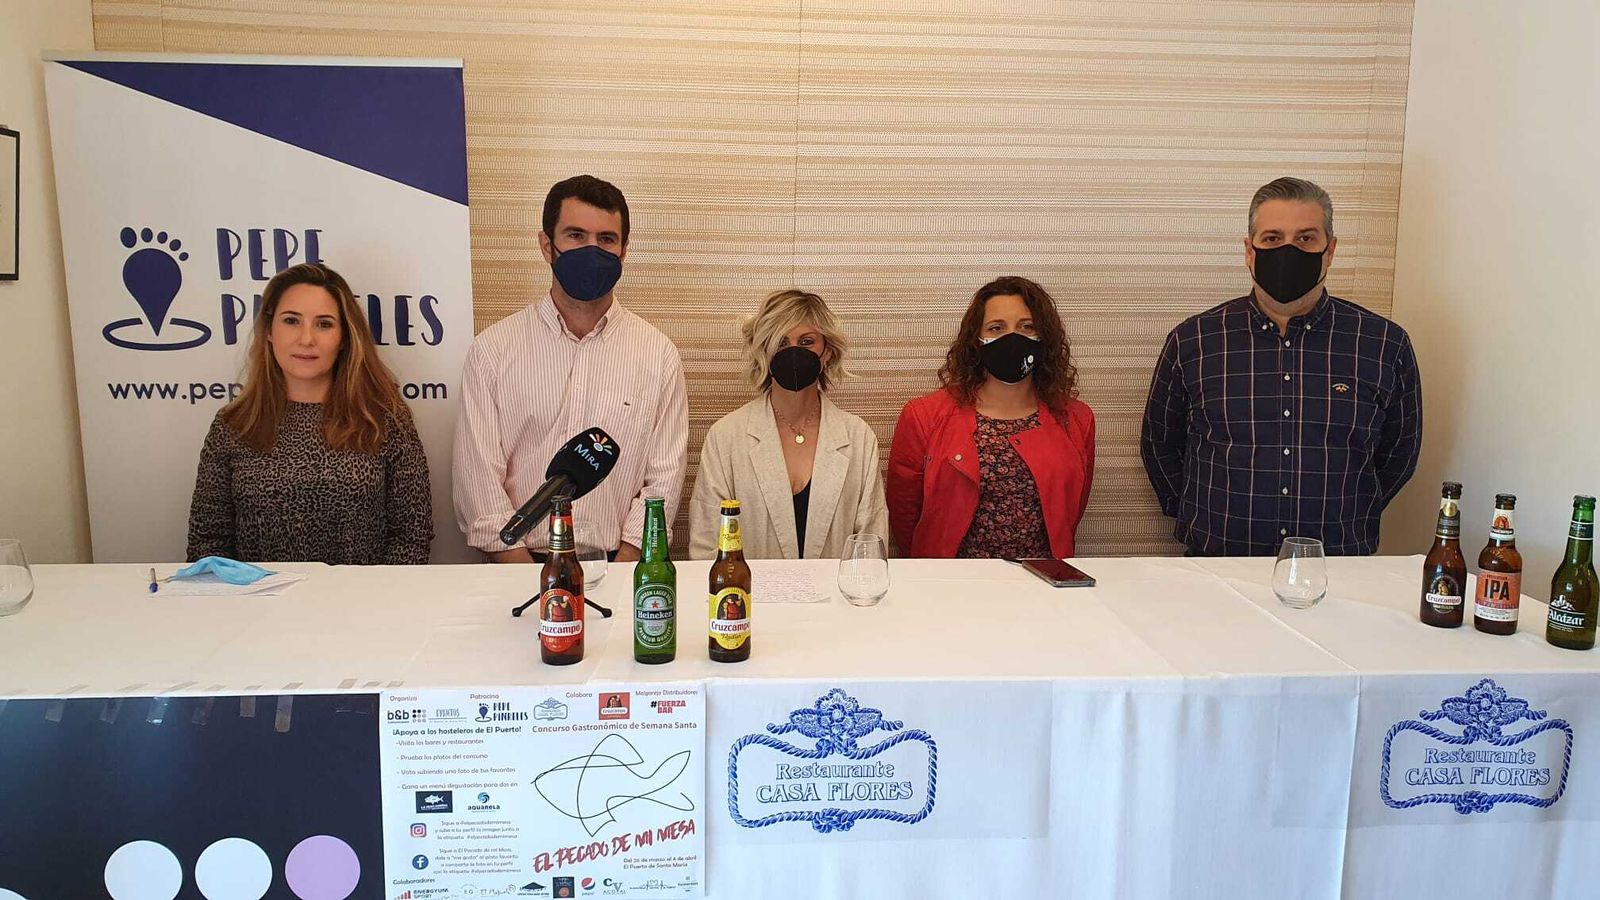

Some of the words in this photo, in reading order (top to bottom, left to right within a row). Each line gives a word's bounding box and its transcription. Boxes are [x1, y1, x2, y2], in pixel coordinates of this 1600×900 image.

[216, 228, 323, 281] PEPE
[574, 444, 599, 470] MIRA
[1484, 579, 1510, 601] IPA
[638, 610, 673, 619] Heineken
[1549, 610, 1585, 626] Alcázar
[712, 621, 750, 631] Cruzcampo
[388, 710, 410, 720] b&b
[572, 722, 628, 732] Gastronómico
[1424, 748, 1536, 765] Restaurante
[776, 761, 895, 780] Restaurante
[1405, 767, 1464, 786] CASA
[1470, 767, 1551, 786] FLORES
[756, 782, 822, 803] CASA
[828, 781, 914, 802] FLORES
[533, 852, 554, 874] EL
[553, 841, 610, 869] PECADO
[612, 833, 632, 857] DE
[635, 829, 653, 848] MI
[657, 819, 695, 842] MESA
